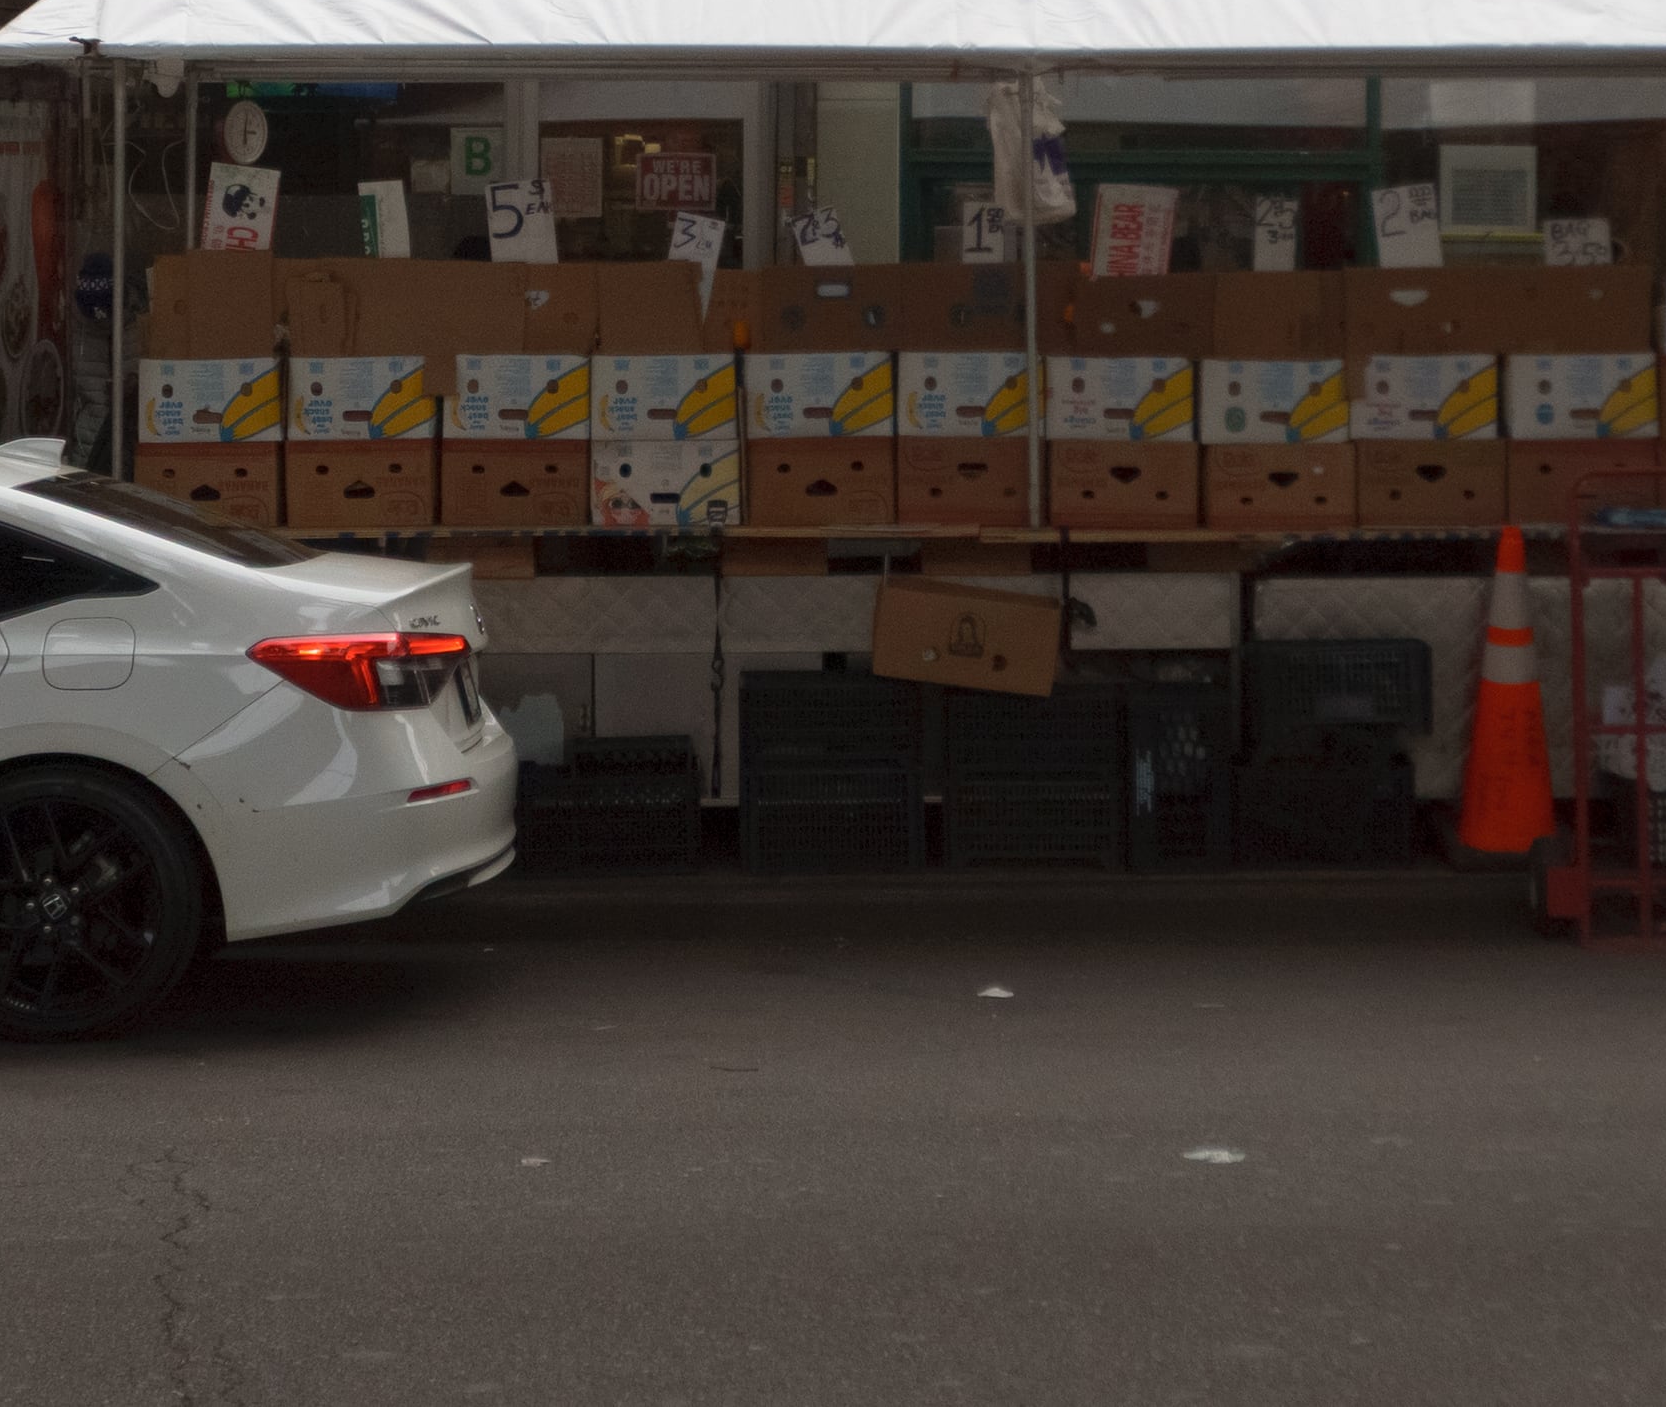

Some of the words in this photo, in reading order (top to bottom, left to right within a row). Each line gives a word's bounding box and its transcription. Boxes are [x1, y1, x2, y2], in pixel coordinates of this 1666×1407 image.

[464, 135, 493, 176] B
[652, 159, 702, 174] WE'RE
[643, 174, 711, 201] OPEN
[490, 183, 524, 239] 5
[965, 208, 994, 254] 1
[1108, 201, 1145, 241] BEAR
[1378, 188, 1406, 238] 2
[1106, 243, 1141, 277] HINA
